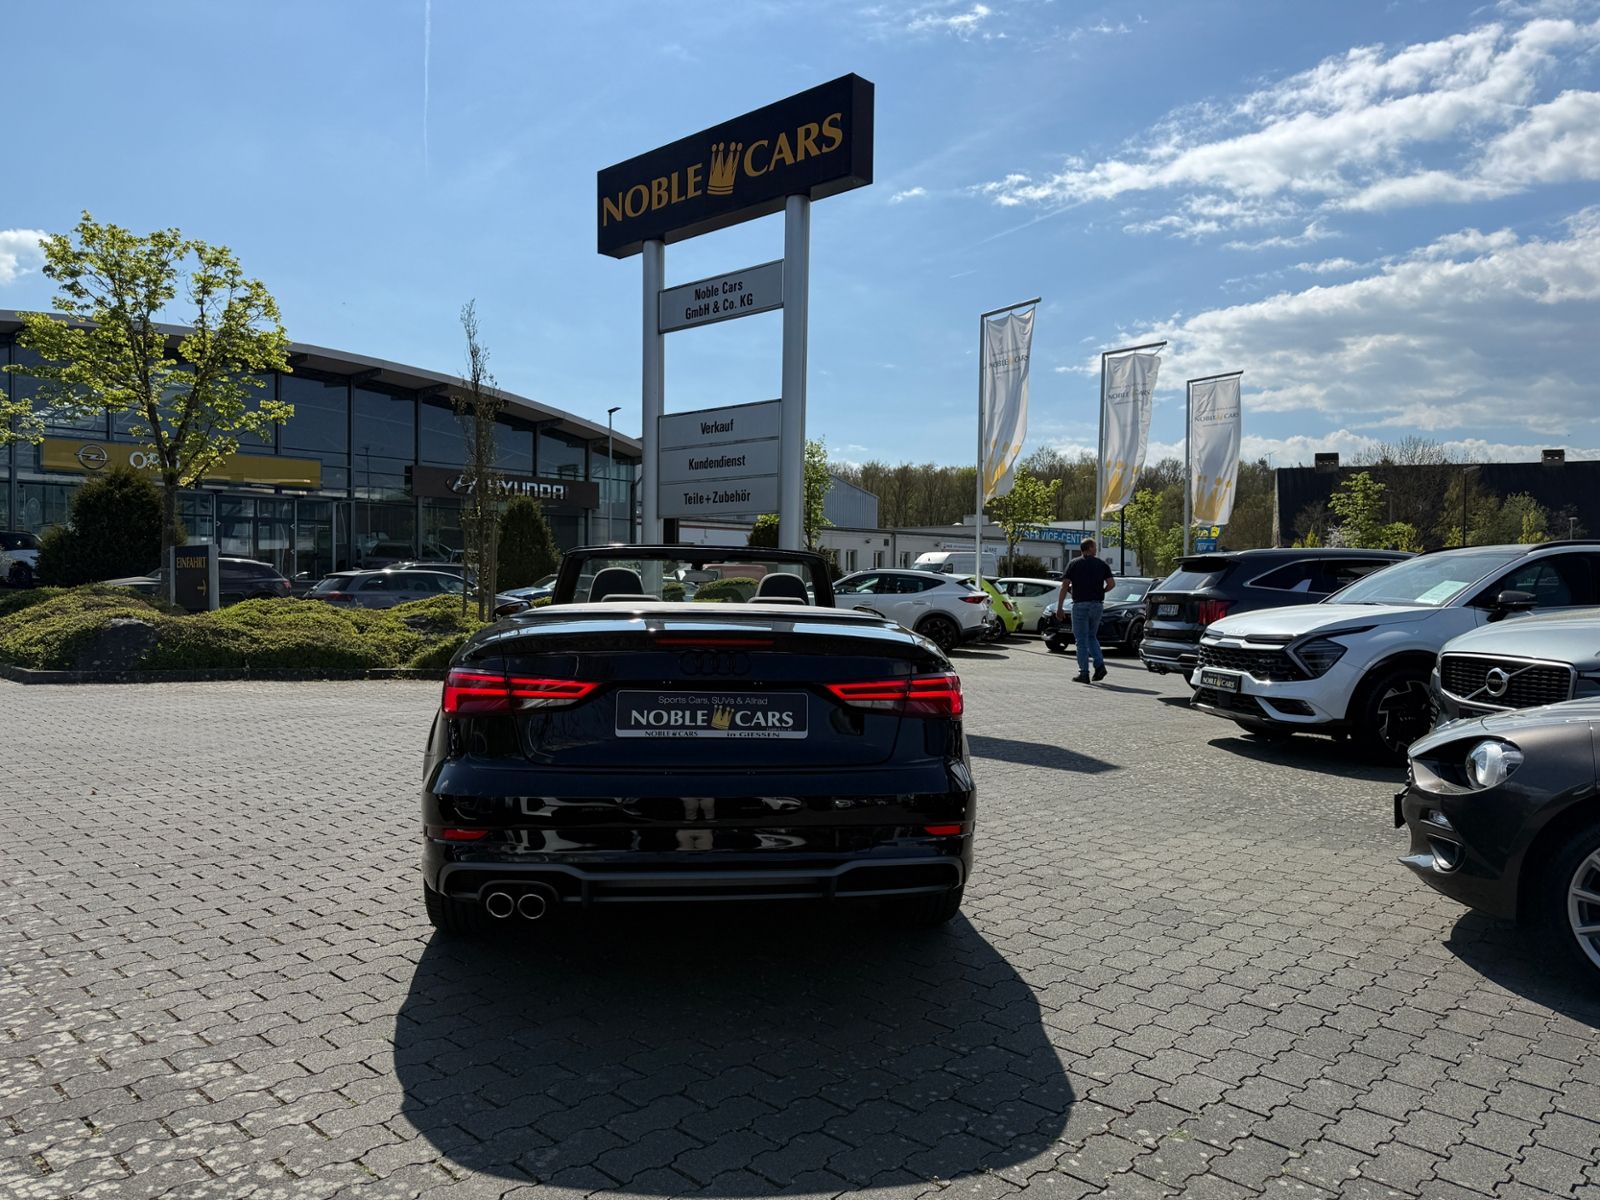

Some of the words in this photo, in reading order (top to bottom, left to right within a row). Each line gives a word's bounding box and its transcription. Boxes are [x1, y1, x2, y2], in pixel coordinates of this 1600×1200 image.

[603, 163, 703, 227] NOBLE
[743, 112, 843, 177] CARS
[695, 285, 719, 301] Noble
[722, 281, 743, 294] Cars
[686, 303, 709, 320] GmbH
[712, 301, 720, 313] &
[723, 298, 736, 311] Co.
[740, 293, 753, 307] KG
[700, 418, 734, 435] Verkauf
[688, 455, 746, 471] Kundendienst
[683, 489, 751, 505] Teile+Zubehör
[176, 556, 208, 569] EINFAHRT
[658, 695, 686, 705] Sports
[688, 696, 710, 705] Cars,
[711, 696, 735, 705] SUVs
[736, 696, 743, 705] &
[745, 696, 768, 705] Allrad
[631, 709, 708, 726] NOBLE
[734, 710, 794, 727] CARS
